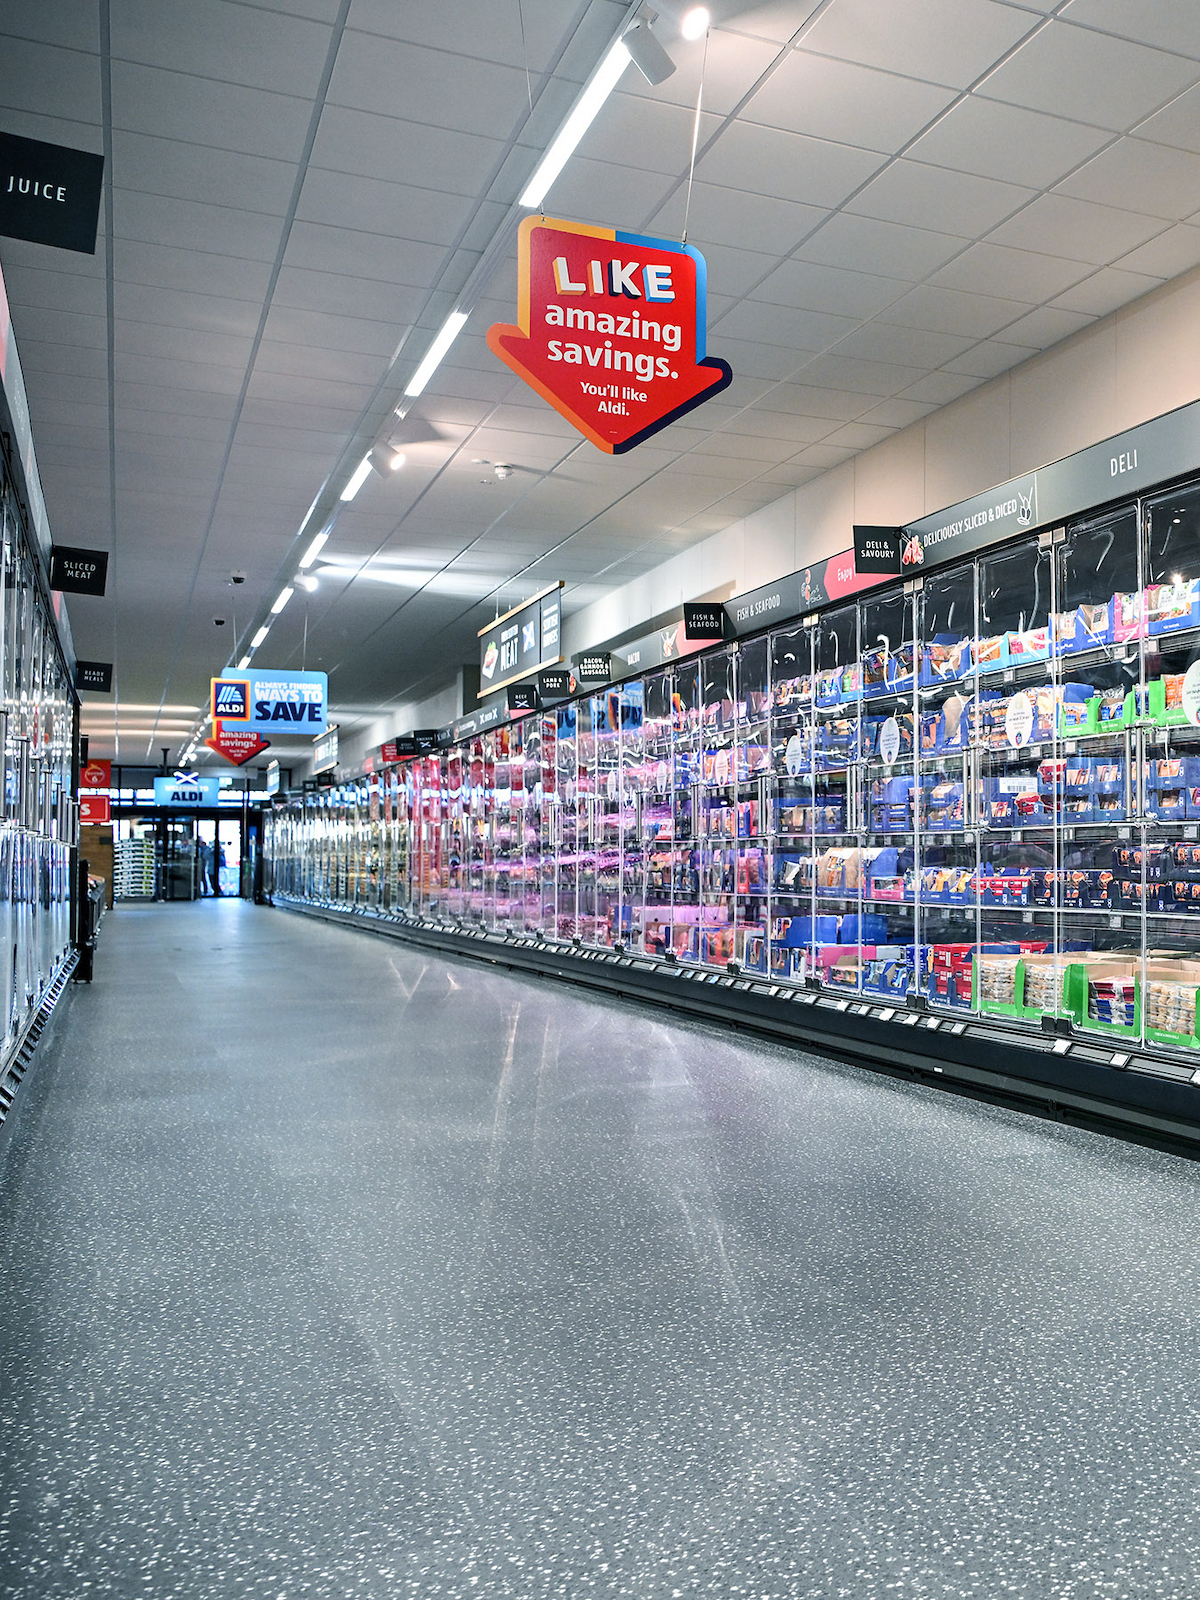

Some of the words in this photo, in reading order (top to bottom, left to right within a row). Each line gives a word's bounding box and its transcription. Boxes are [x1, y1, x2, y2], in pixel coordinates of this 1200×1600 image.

[7, 175, 68, 203] JUICE
[553, 256, 676, 303] LIKE
[545, 304, 682, 352] amazing
[547, 340, 679, 382] savings.
[580, 381, 619, 399] You'll
[622, 386, 648, 402] like
[597, 400, 630, 416] Aldi.
[1109, 448, 1139, 478] DELI
[923, 520, 964, 548] DELICIOUSLY
[964, 510, 988, 532] SLICED
[988, 507, 995, 522] &
[995, 498, 1018, 519] DICED
[865, 540, 882, 549] DELI
[883, 541, 889, 549] &
[860, 549, 895, 558] SAVOURY
[63, 560, 97, 572] SLICED
[66, 570, 92, 580] MEAT
[837, 567, 852, 582] Enjoy
[737, 607, 750, 622] FISH
[750, 603, 755, 617] &
[755, 593, 781, 615] SEAFOOD
[688, 620, 720, 628] SEAFOOD
[692, 613, 709, 621] FISH
[709, 613, 715, 621] &
[500, 637, 519, 672] MEAT
[581, 668, 609, 676] SAUSAGES
[254, 689, 300, 702] WAYS
[302, 689, 323, 703] TO
[217, 704, 244, 713] ALDI
[255, 701, 322, 722] SAVE
[220, 731, 257, 740] amazing
[220, 739, 256, 748] savings.
[170, 791, 203, 801] ALDI
